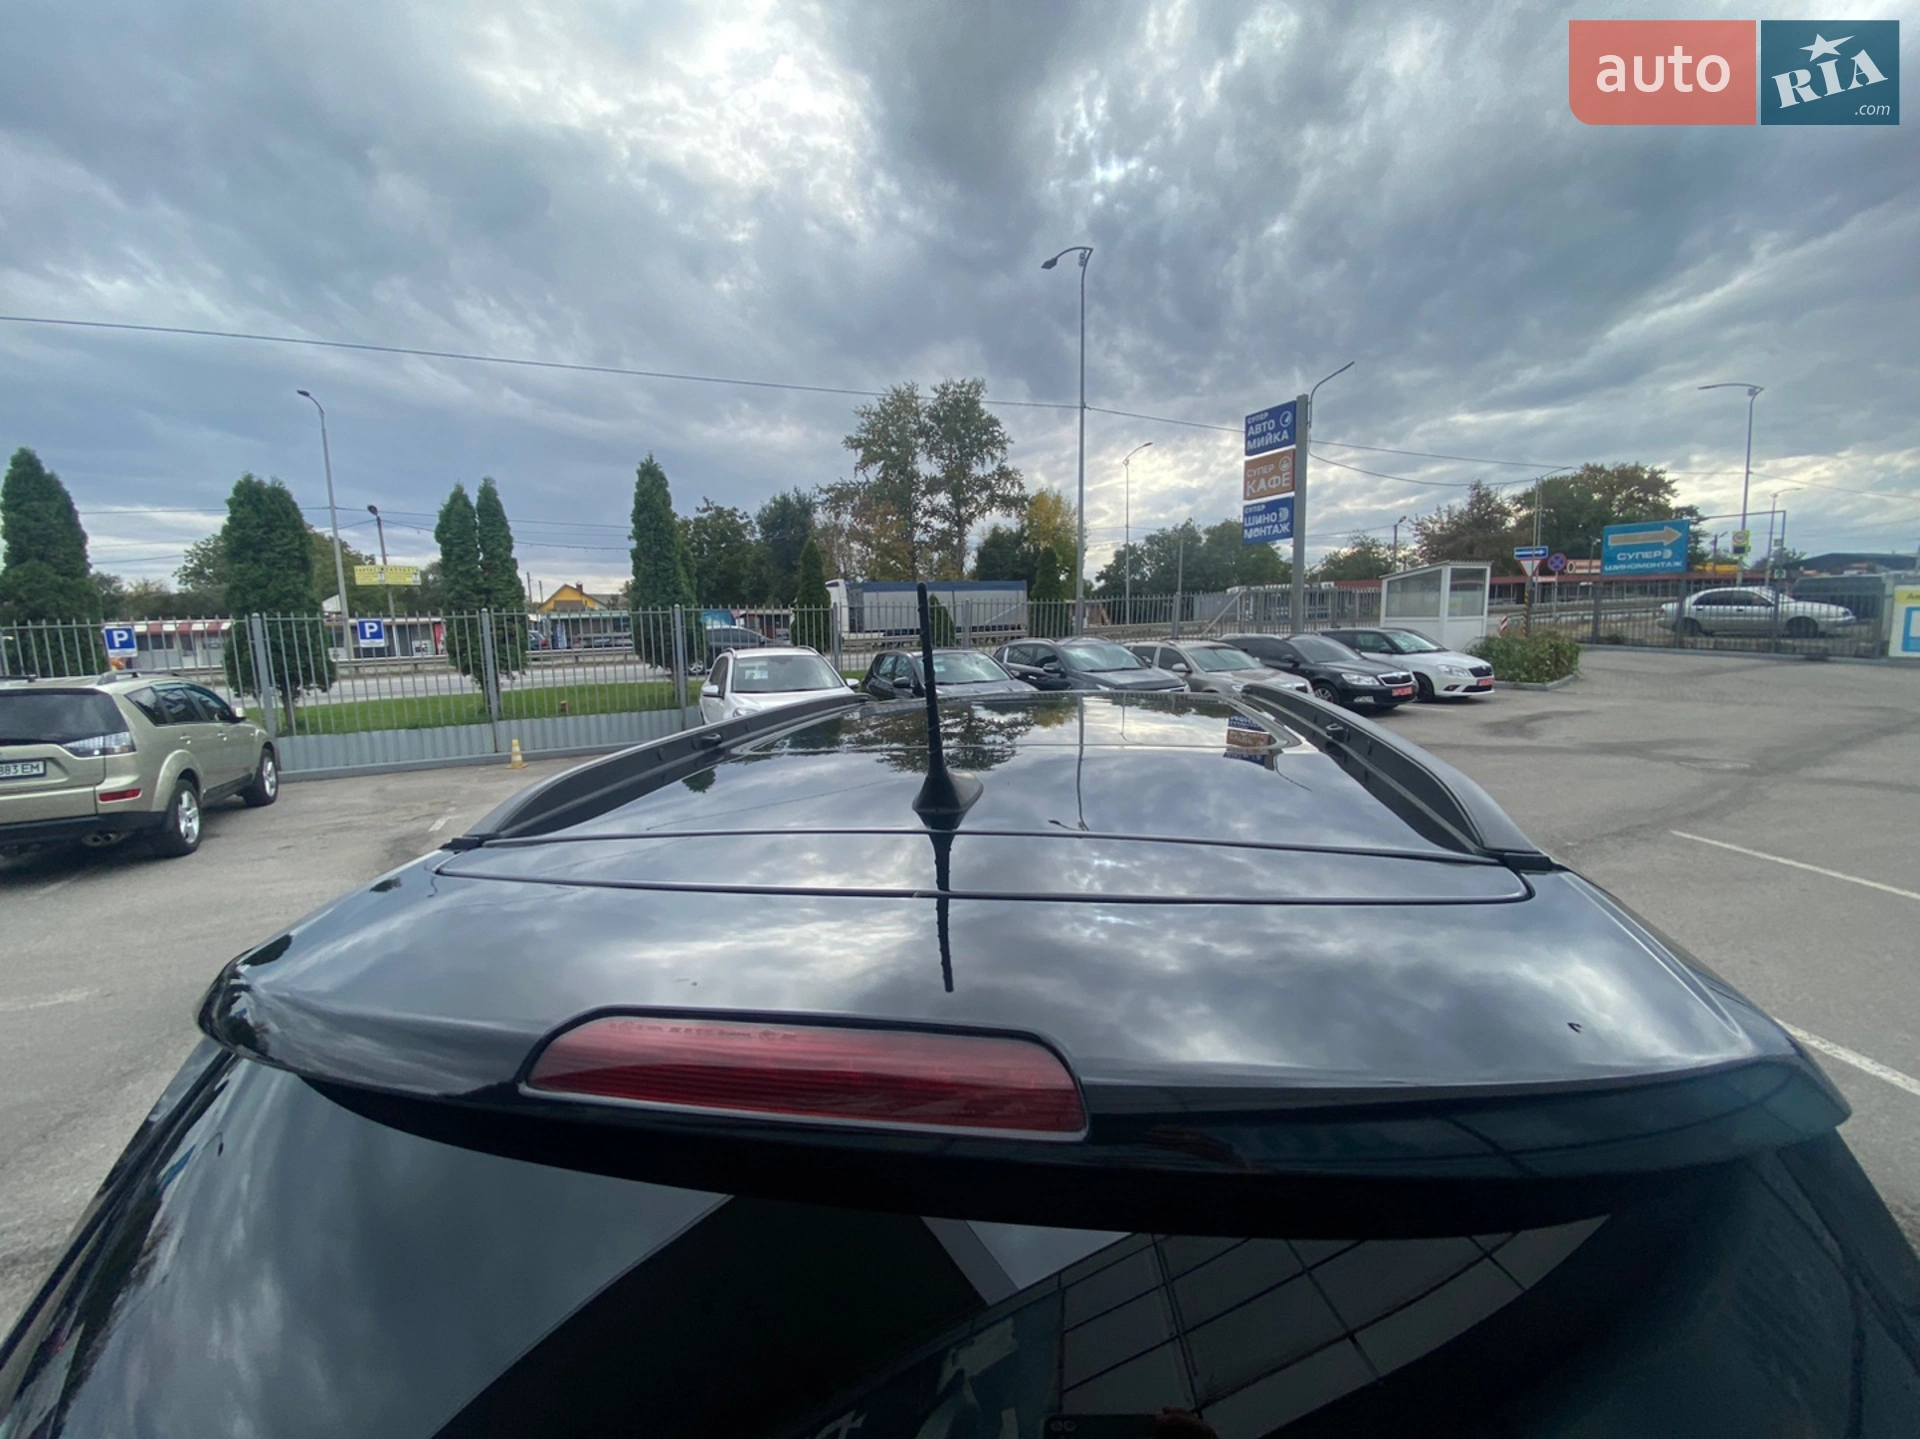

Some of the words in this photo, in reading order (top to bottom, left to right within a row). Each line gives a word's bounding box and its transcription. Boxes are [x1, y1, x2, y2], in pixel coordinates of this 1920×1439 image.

[1247, 419, 1276, 437] АВТО
[1247, 429, 1289, 451] МИЙКА
[1246, 463, 1275, 477] СУПЕР
[1246, 472, 1291, 497] КАФЕ
[1244, 511, 1278, 527] ШИНО
[1243, 522, 1291, 539] МОНТАЖ
[1616, 549, 1662, 561] СУПЕР
[1604, 560, 1682, 572] ШИНОМОНТАЖ
[364, 622, 379, 638] P
[112, 630, 129, 648] P
[21, 763, 41, 774] EM
